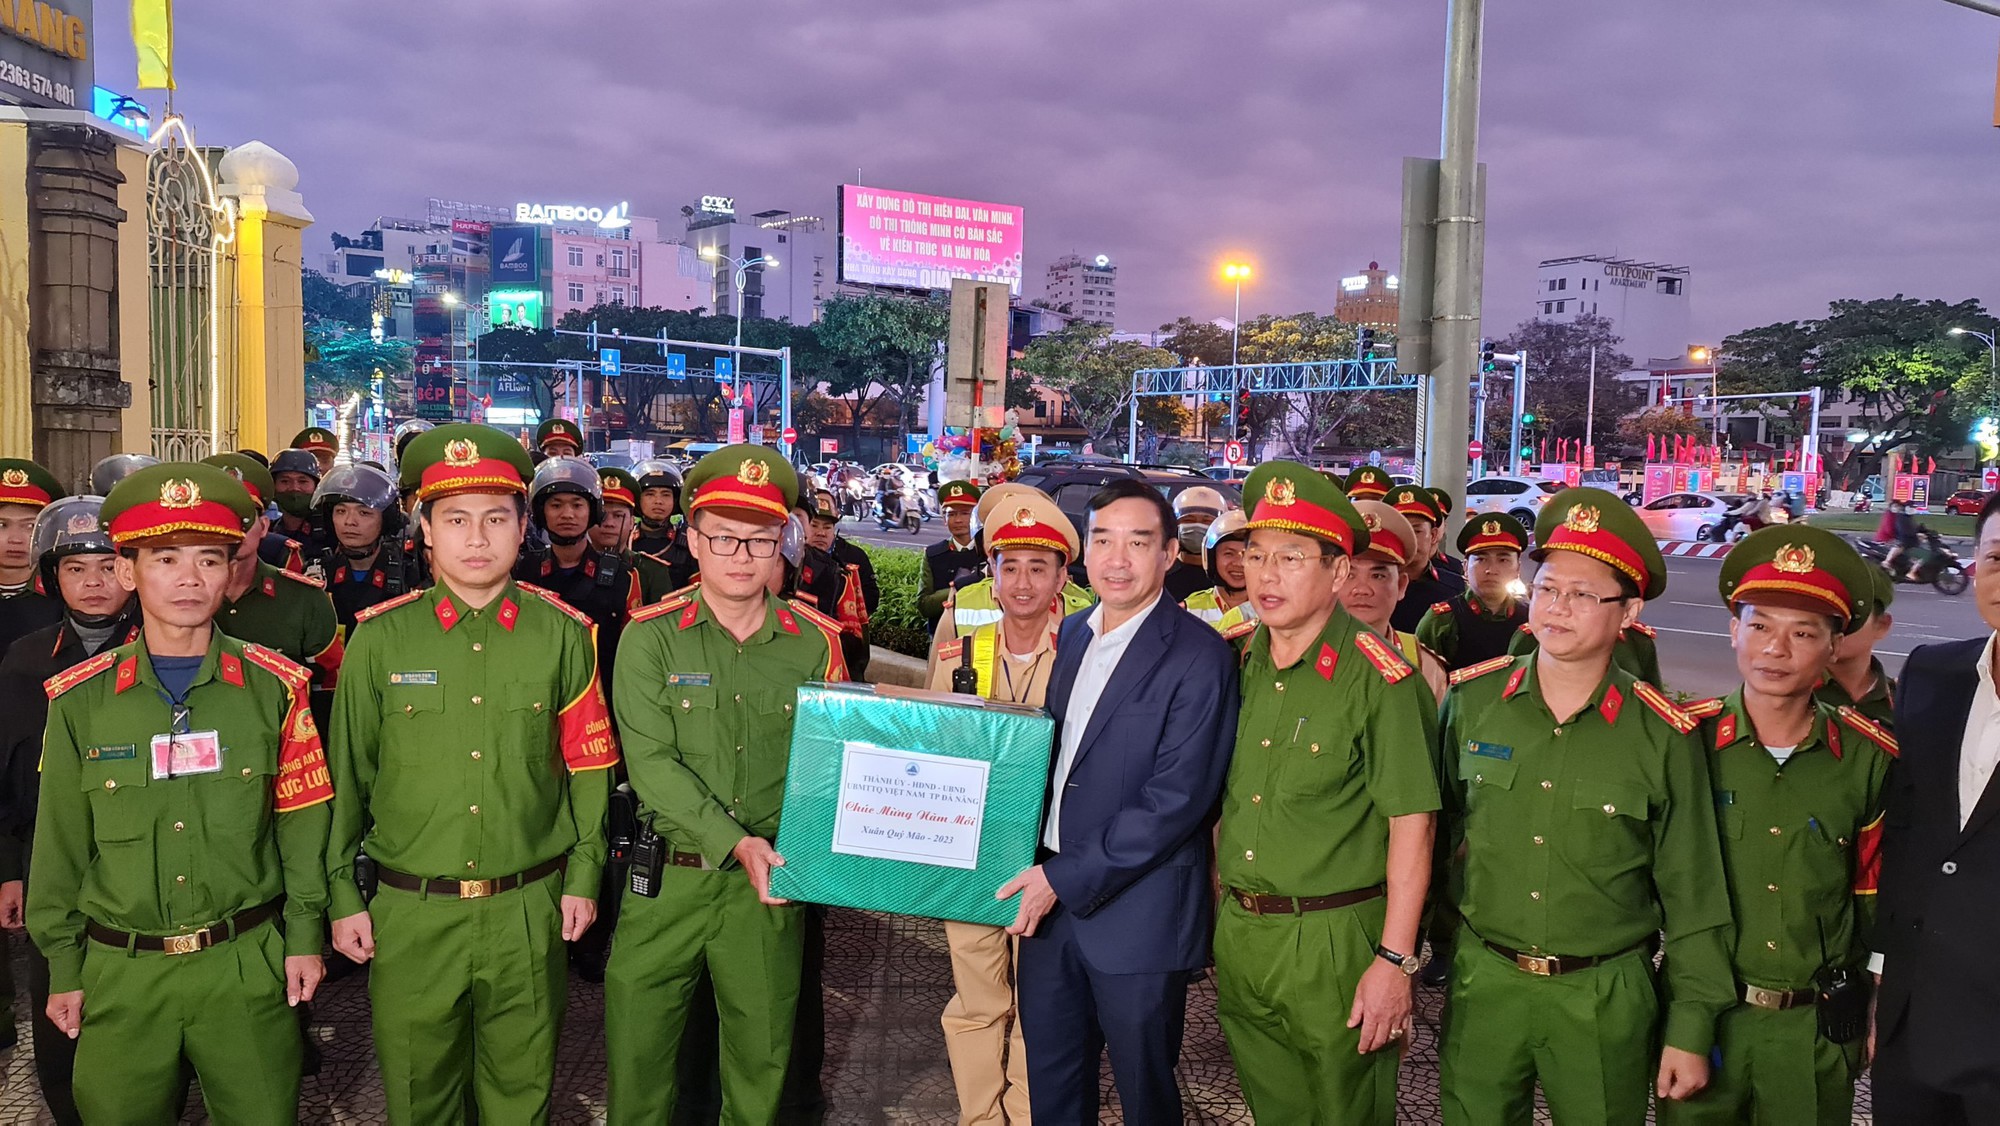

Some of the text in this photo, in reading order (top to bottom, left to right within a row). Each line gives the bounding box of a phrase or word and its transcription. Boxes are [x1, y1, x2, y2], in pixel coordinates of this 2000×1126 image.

[32, 74, 53, 98] 574
[54, 82, 75, 107] 801
[516, 203, 603, 222] BAMBOO
[857, 192, 874, 208] XÂY
[917, 201, 932, 218] THỊ
[933, 202, 953, 220] HIỆN
[991, 210, 1014, 226] MINH,
[900, 218, 928, 236] THÔNG
[930, 223, 951, 238] MINH
[954, 224, 966, 240] CÓ
[914, 241, 938, 257] TRÚC
[941, 242, 953, 258] VÀ
[1604, 265, 1655, 281] CITYPOINT
[1610, 278, 1647, 289] APARTMENT
[655, 422, 684, 433] Pineapple
[585, 718, 607, 735] CÔNG
[581, 737, 609, 757] LỰC
[303, 751, 315, 766] AN
[847, 782, 883, 795] UBMTTQ
[885, 786, 903, 797] VIỆT
[906, 789, 925, 799] NAM
[929, 792, 940, 800] TP
[863, 775, 893, 786] THÀNH
[942, 785, 966, 794] UBND
[845, 801, 875, 815] Chúc
[861, 825, 885, 836] Xuân
[933, 834, 954, 845] 2023
